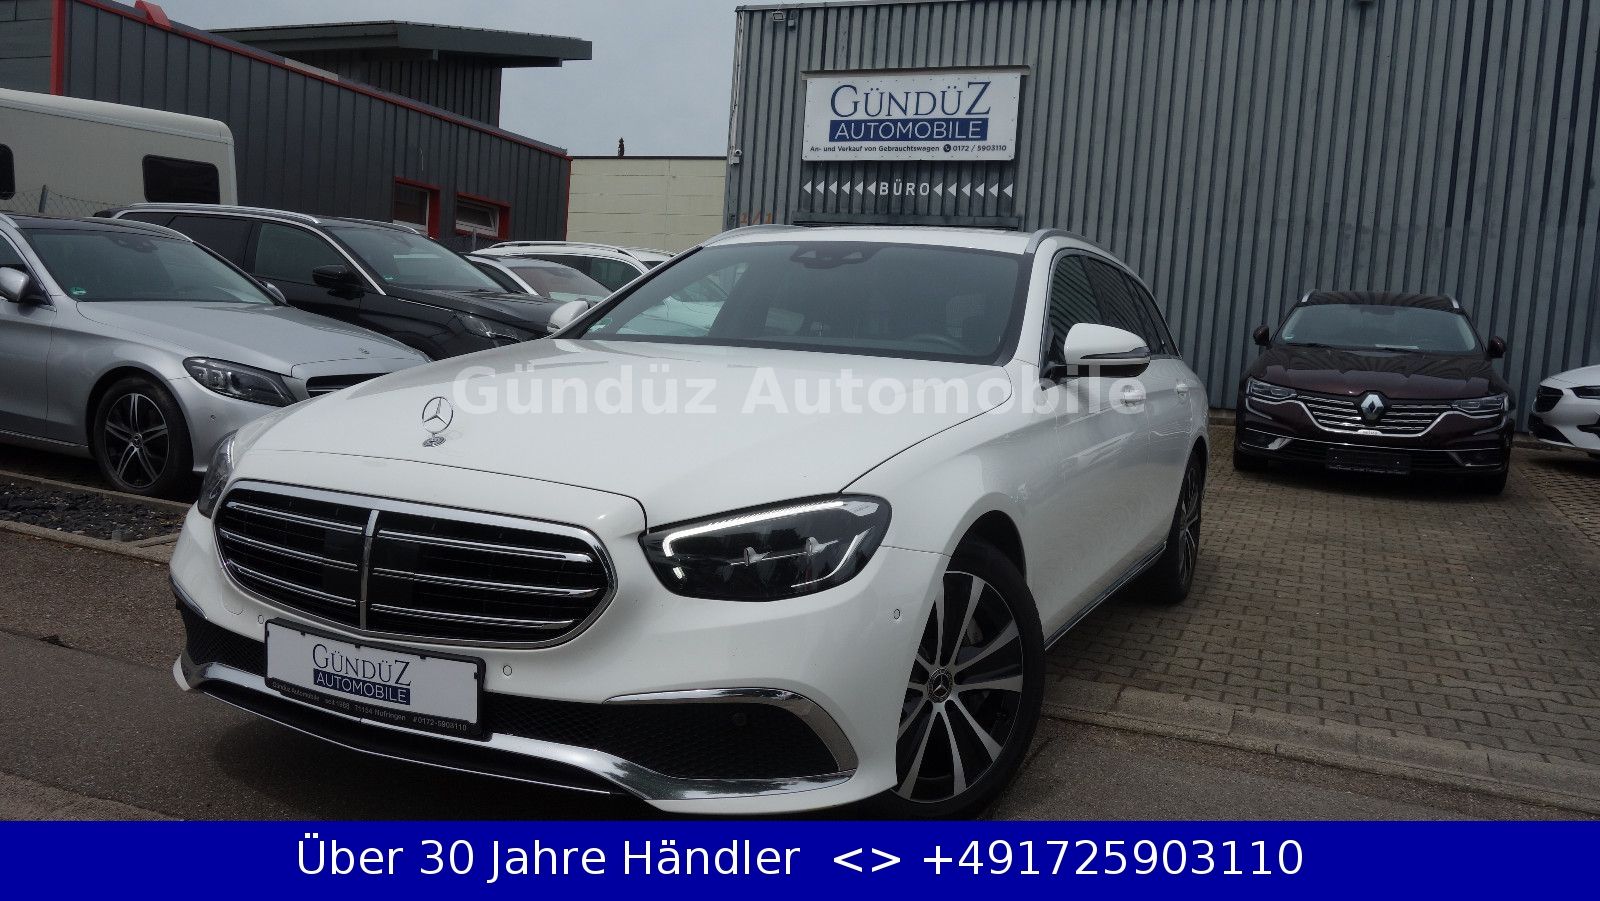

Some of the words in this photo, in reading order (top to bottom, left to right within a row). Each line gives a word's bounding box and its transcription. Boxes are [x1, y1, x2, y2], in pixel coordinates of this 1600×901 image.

[834, 120, 982, 141] AUTOMOBILE
[878, 145, 940, 153] Gebrauchtswagen
[879, 180, 931, 196] BÜRO
[316, 671, 407, 703] AUTOMOBILE
